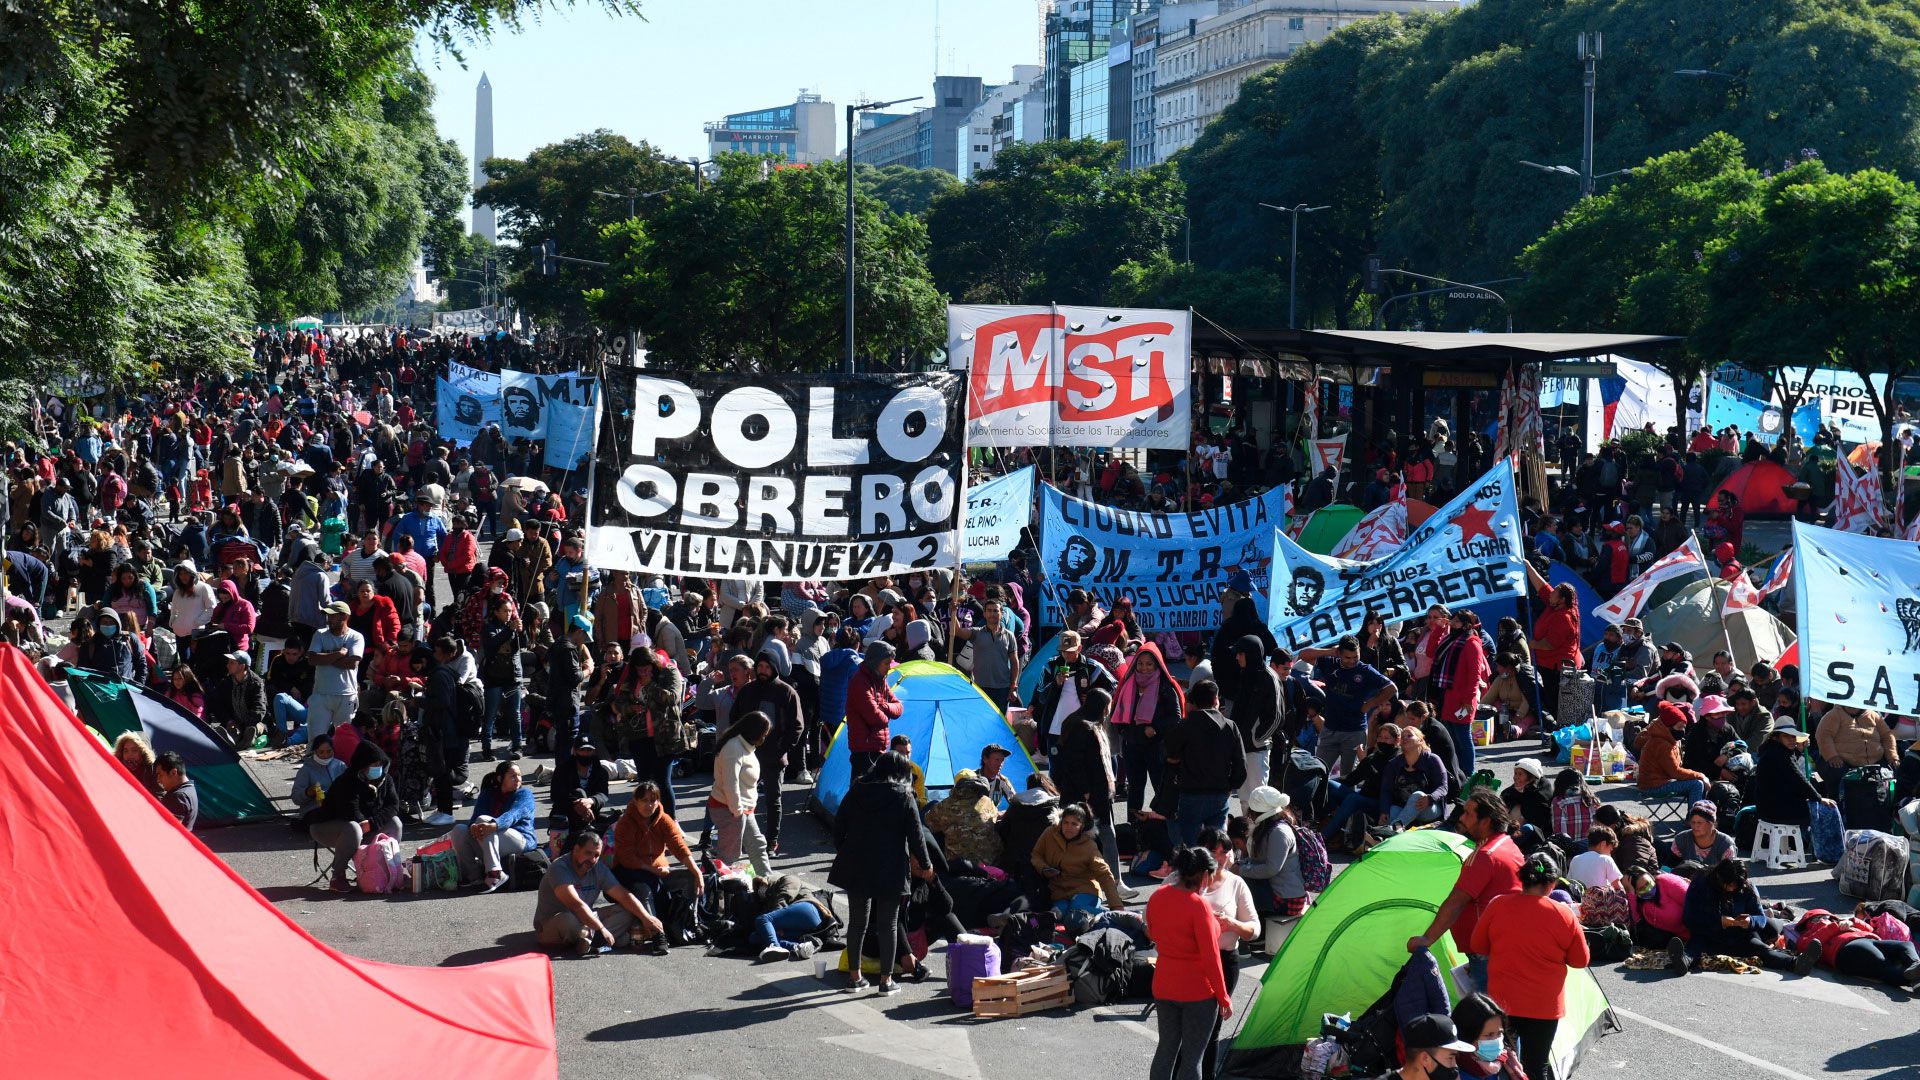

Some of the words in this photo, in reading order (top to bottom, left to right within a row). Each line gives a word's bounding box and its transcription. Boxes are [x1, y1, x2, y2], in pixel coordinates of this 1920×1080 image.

[984, 326, 1165, 412] MST
[631, 374, 947, 468] POLO
[1831, 398, 1875, 418] PIE
[968, 425, 1024, 438] Movimiento
[1027, 425, 1071, 437] Socialista
[1073, 425, 1087, 436] de
[1089, 425, 1102, 437] los
[1105, 425, 1169, 440] Trabajadores
[616, 464, 955, 536] OBRERO
[1061, 495, 1173, 539] CIUDAD
[1186, 495, 1268, 539] EVITA
[630, 530, 893, 578] VILLANUEVA
[911, 536, 939, 569] 2
[968, 535, 1000, 547] LUCHAR
[1169, 609, 1208, 628] CAMBIO
